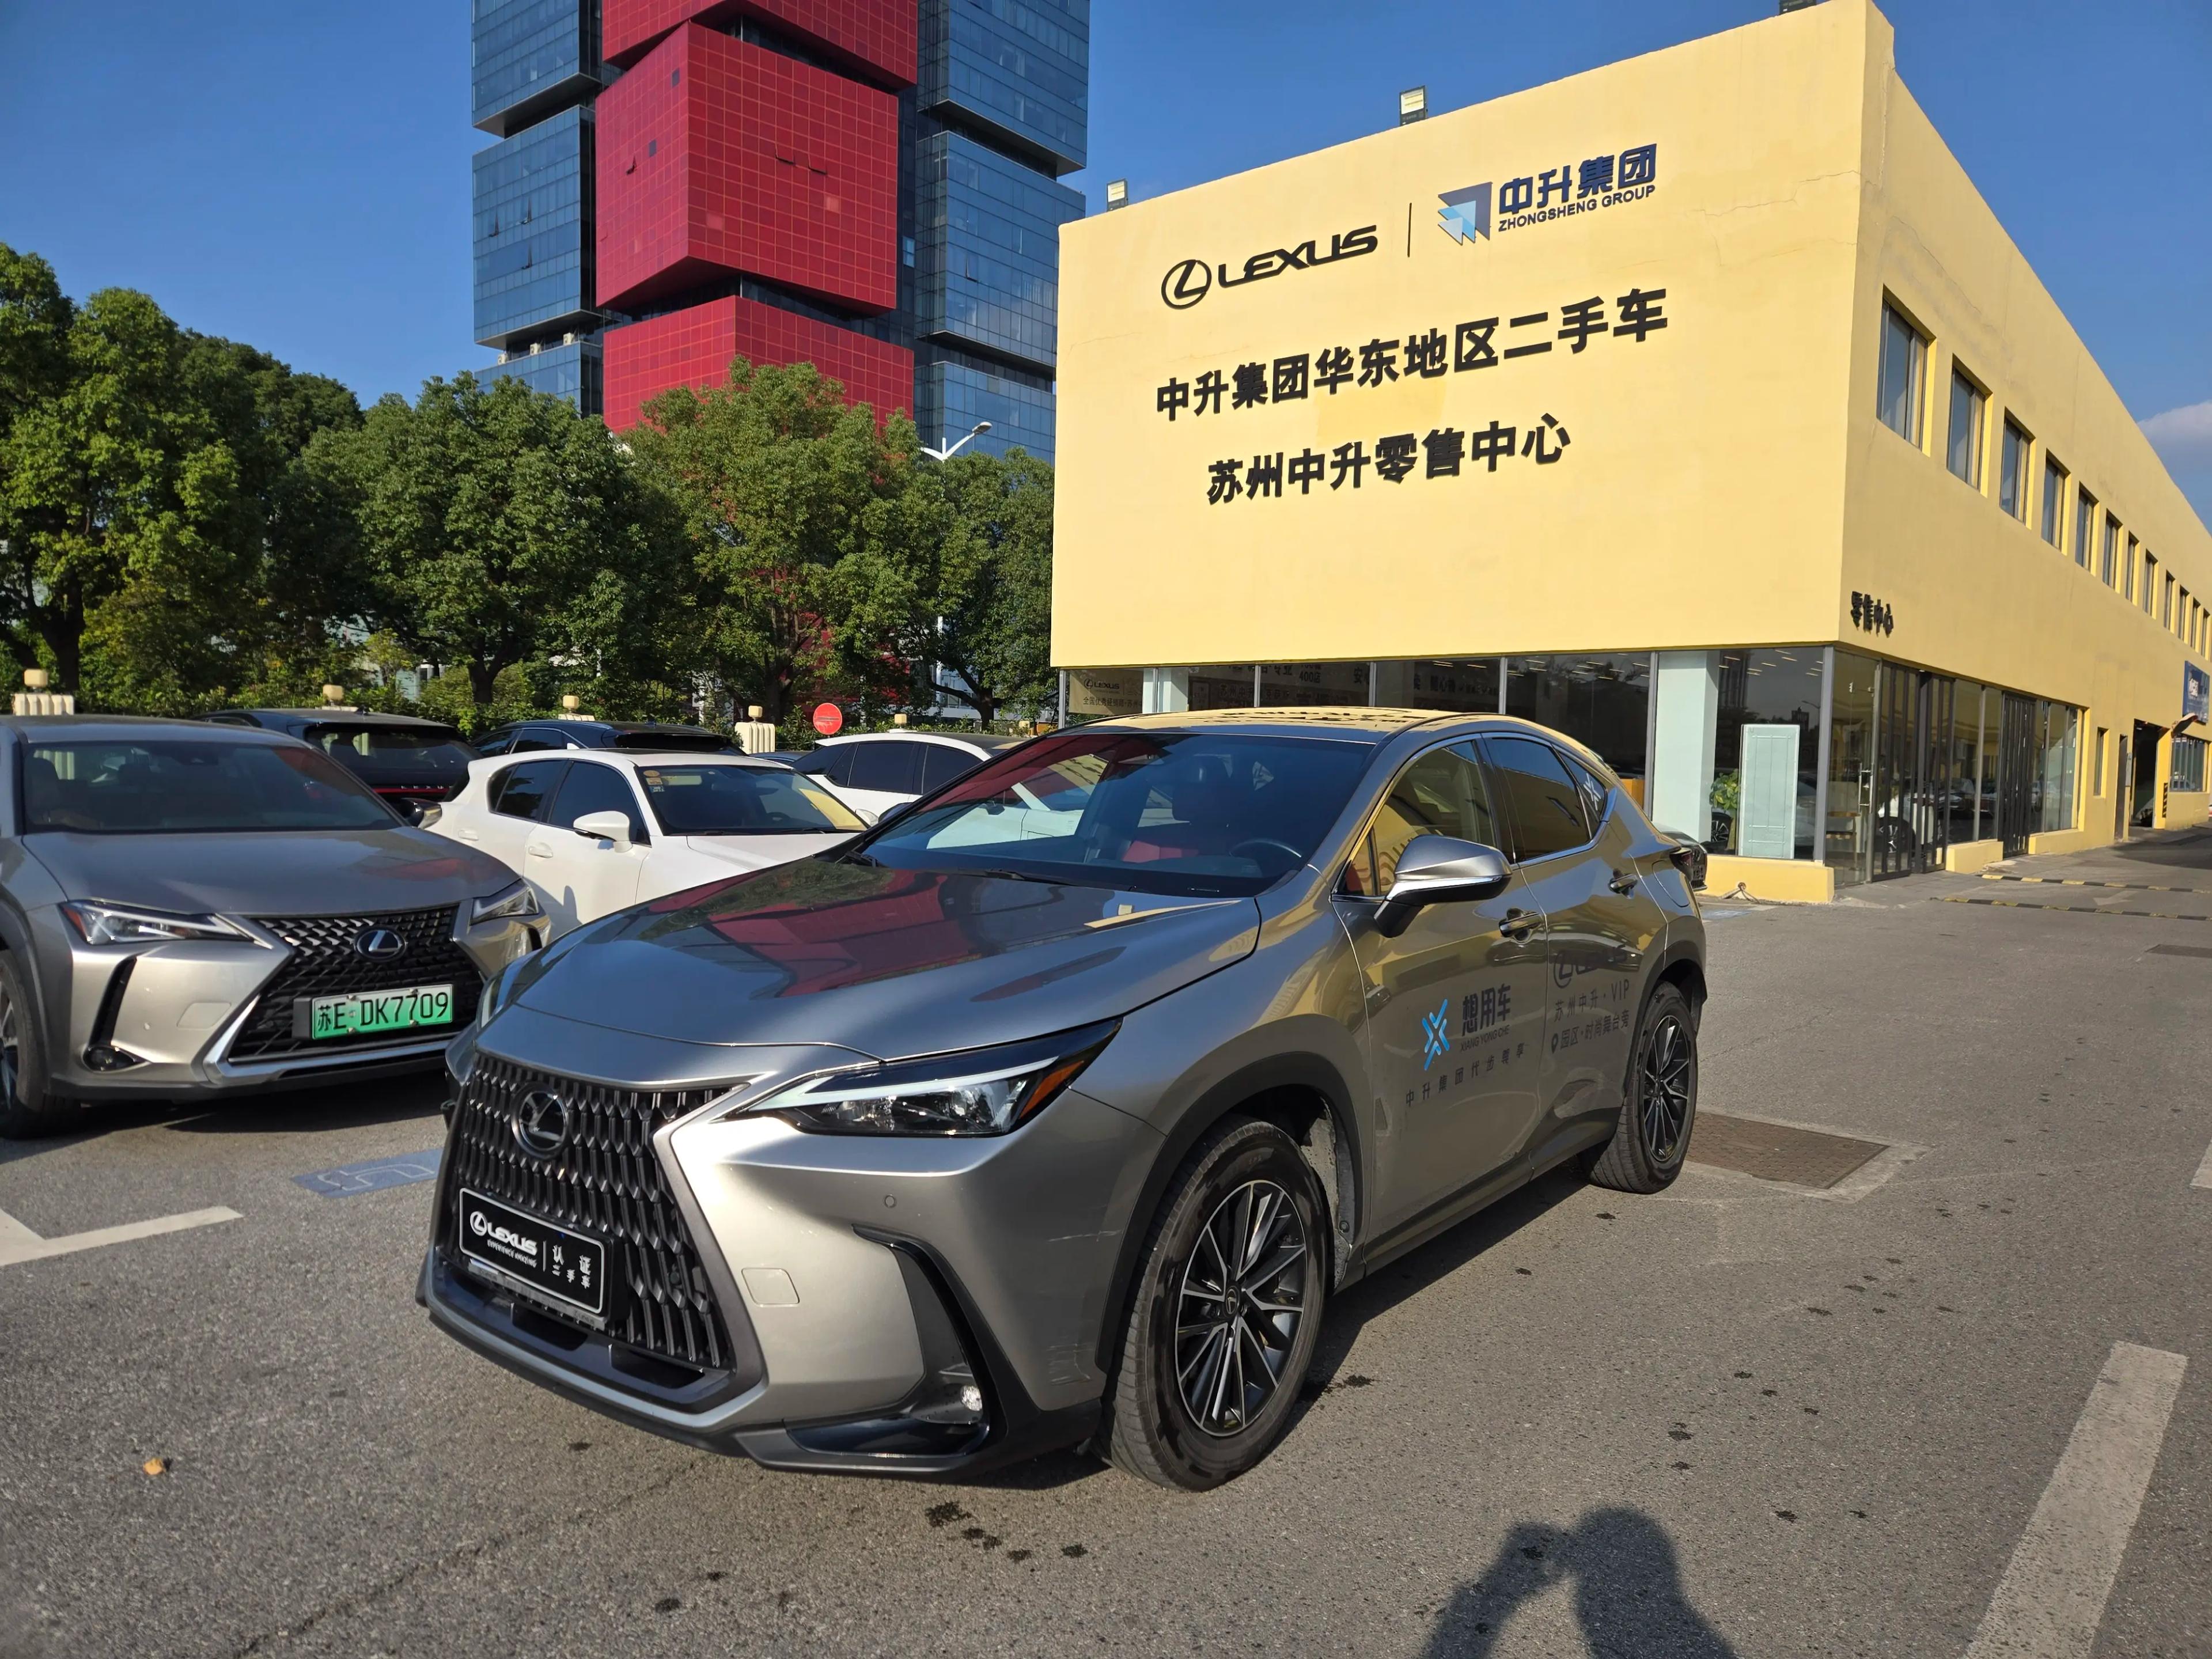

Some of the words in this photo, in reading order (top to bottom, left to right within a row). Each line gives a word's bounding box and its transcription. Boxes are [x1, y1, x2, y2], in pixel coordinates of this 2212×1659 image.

[1499, 143, 1657, 216] 中升集团
[1498, 200, 1597, 232] ZHONGSHENG
[1601, 184, 1656, 207] GROUP
[1218, 225, 1378, 288] LEXUS
[1157, 289, 1668, 422] 中升集团华东地区二手车
[1207, 412, 1571, 505] 苏州中升零售中心
[1850, 591, 1894, 637] 零售中心
[1094, 681, 1120, 690] LEXUS
[1462, 983, 1511, 1036] 想用车
[1460, 1038, 1479, 1052] XIANG
[1480, 1031, 1498, 1047] YONG
[1498, 1025, 1510, 1037] CHE
[487, 1222, 537, 1256] LEXUS
